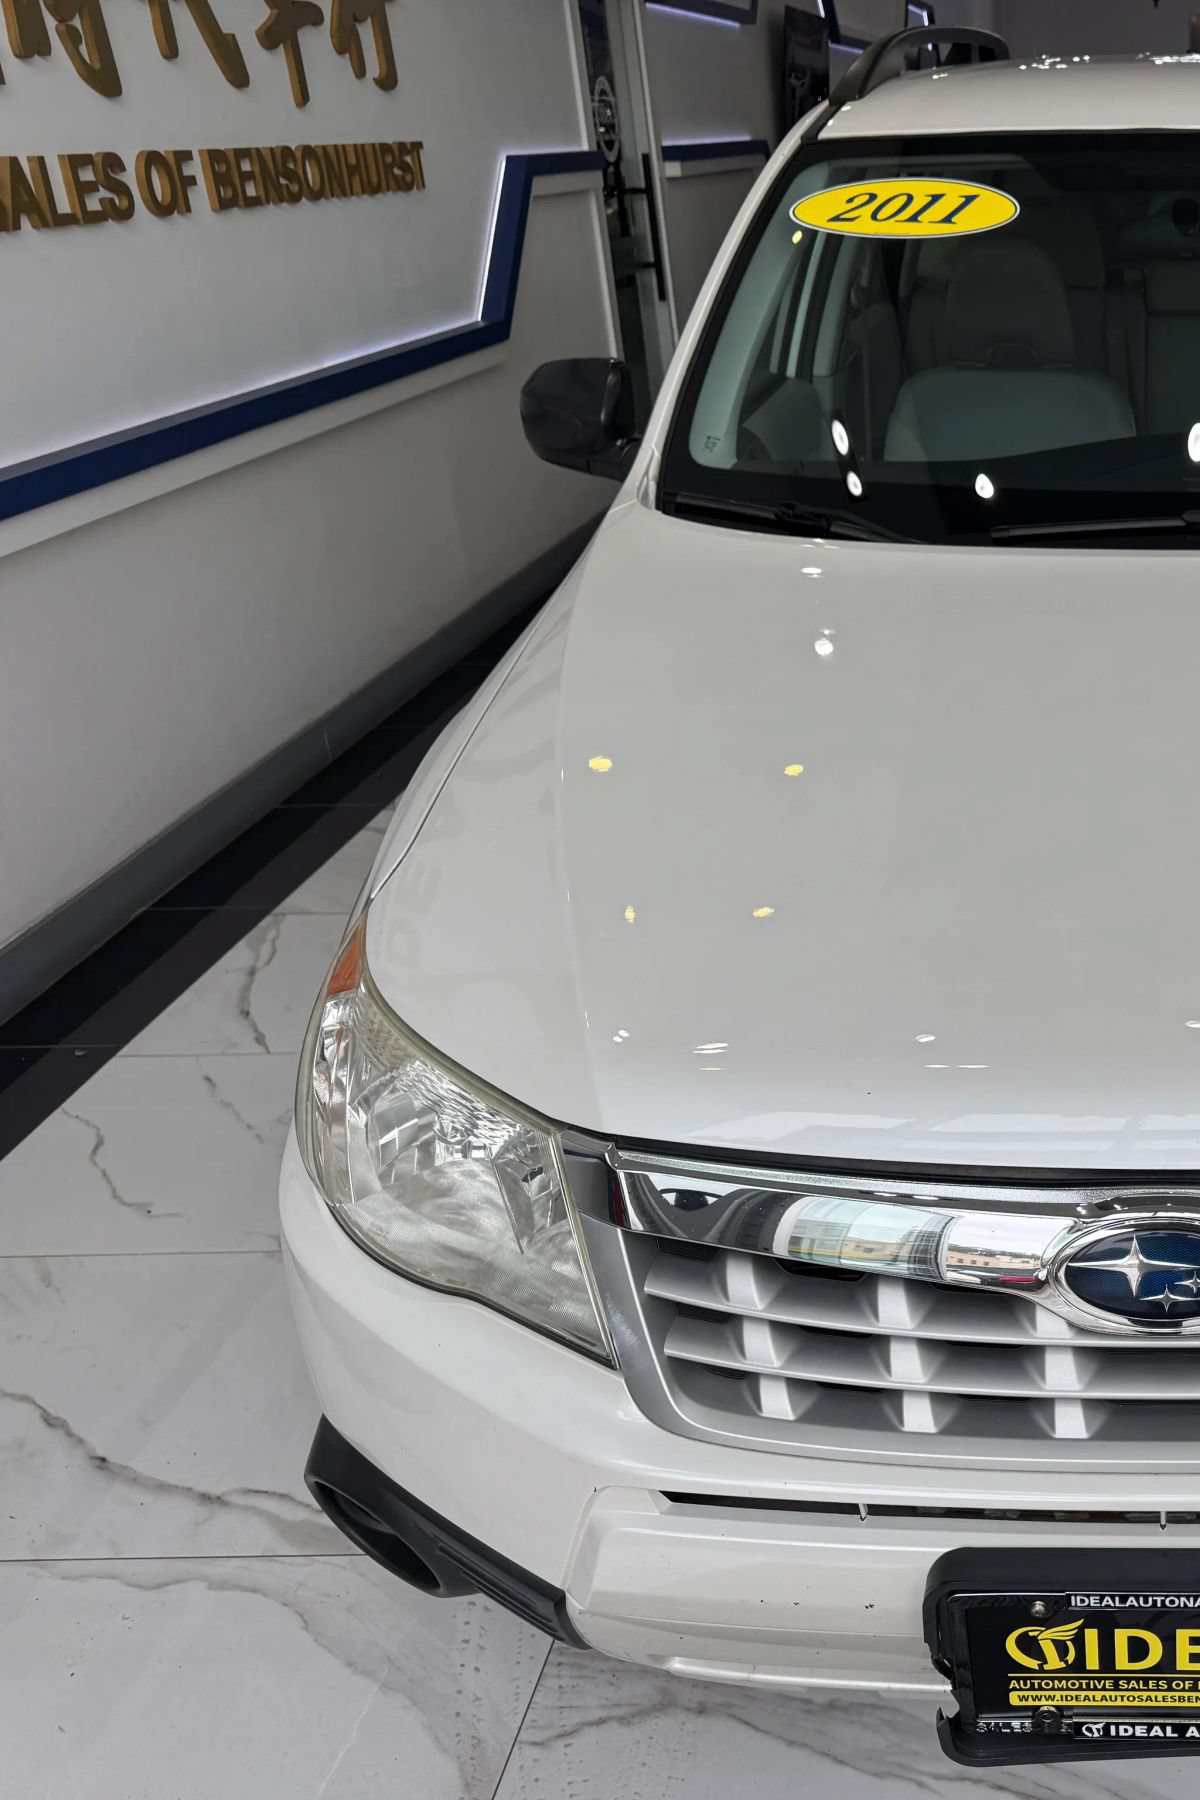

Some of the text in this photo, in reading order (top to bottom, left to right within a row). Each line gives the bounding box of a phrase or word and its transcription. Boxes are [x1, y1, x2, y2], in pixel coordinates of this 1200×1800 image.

[0, 141, 426, 232] ALES OF BENSONHURST
[827, 192, 980, 225] 2011
[1009, 1679, 1114, 1690] AUTOMOTIVE
[1118, 1679, 1166, 1690] SALES
[1173, 1680, 1193, 1691] OF
[1110, 1724, 1178, 1738] IDEAL
